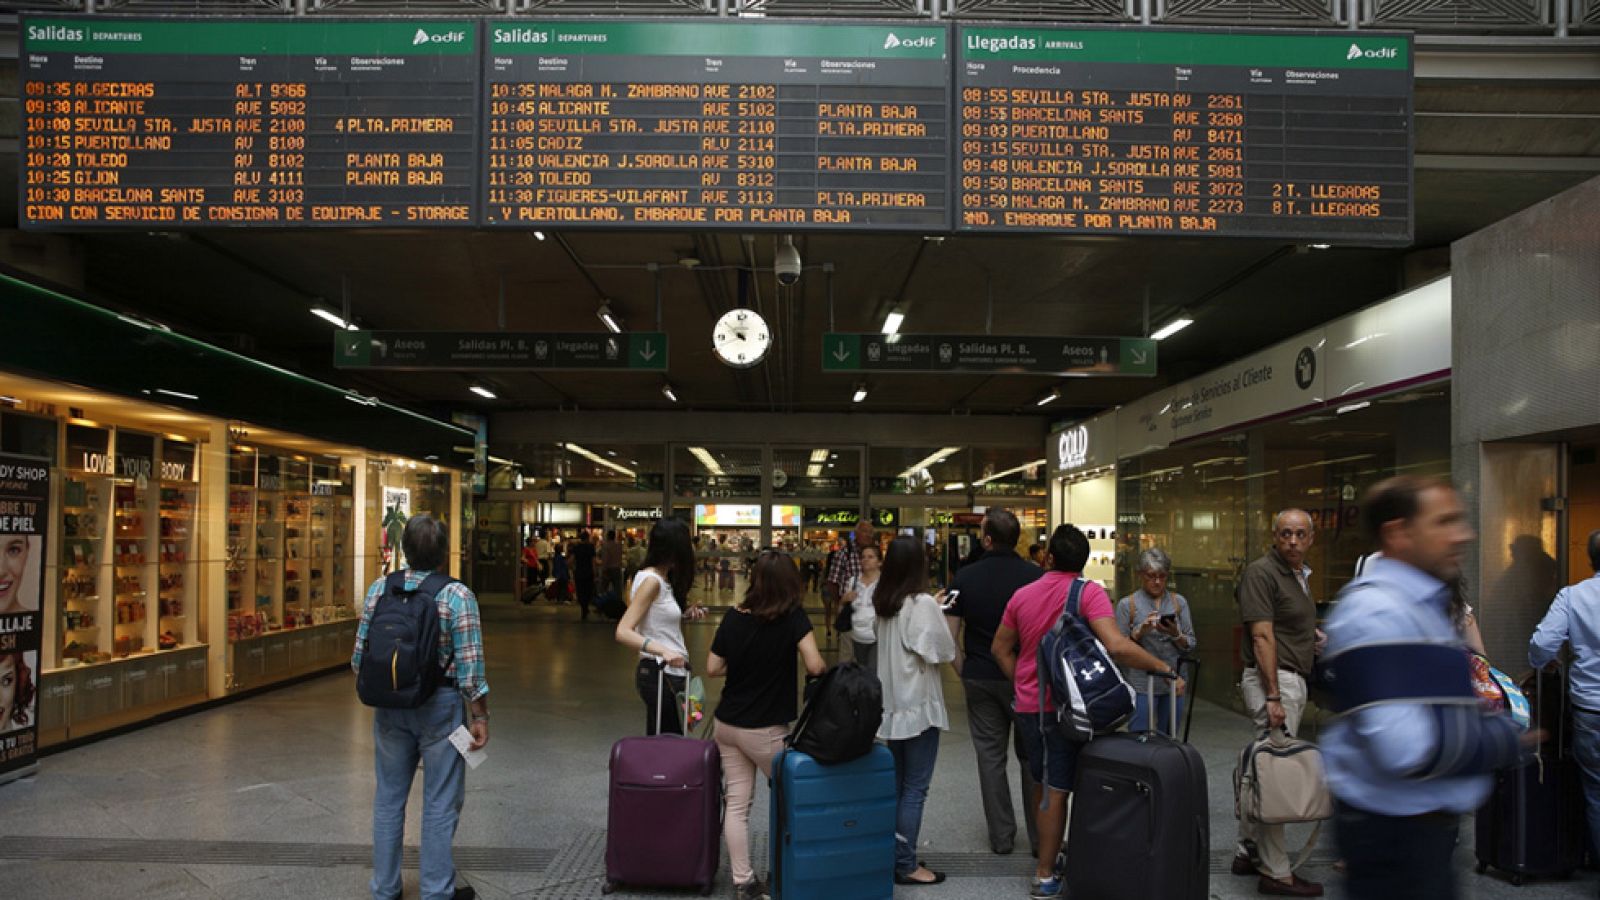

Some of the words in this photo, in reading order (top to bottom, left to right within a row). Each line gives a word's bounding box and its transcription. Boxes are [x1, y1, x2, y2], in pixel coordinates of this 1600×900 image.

[28, 26, 83, 41] Salidas
[93, 33, 142, 41] DEPARTURES
[494, 29, 547, 43] Salidas
[558, 34, 607, 42] DEPARTURES
[967, 36, 1035, 52] Llegadas
[1045, 41, 1083, 49] ARRIVALS
[1013, 65, 1060, 75] Procedencia
[1286, 71, 1338, 79] Observaciones
[74, 82, 154, 97] ALGECIRAS
[236, 84, 261, 98] ALT
[492, 84, 535, 98] 10:35
[539, 84, 593, 97] MALAGA
[628, 84, 699, 98] ZAMBRANO
[704, 85, 729, 98] AVE
[738, 85, 775, 98] 2102
[1011, 90, 1073, 104] SEVILLA
[1126, 93, 1170, 106] JUSTA
[1172, 94, 1191, 107] AV
[74, 100, 144, 114] ALICANTE
[235, 101, 261, 115] AVE
[492, 101, 534, 115] 10:45
[538, 102, 609, 115] ALICANTE
[703, 103, 730, 116] AVE
[738, 103, 775, 116] 5102
[818, 104, 873, 118] PLANTA
[880, 105, 917, 118] BAJA
[1012, 108, 1092, 123] BARCELONA
[1100, 110, 1144, 124] SANTS
[1172, 112, 1198, 125] AVE
[26, 118, 72, 132] 10:00
[74, 118, 136, 132] SEVILLA
[189, 118, 231, 132] JUSTA
[235, 119, 261, 132] AVE
[491, 119, 534, 133] 11:00
[538, 119, 600, 133] SEVILLA
[655, 119, 698, 132] JUSTA
[703, 120, 728, 133] AVE
[738, 120, 775, 134] 2110
[962, 123, 1008, 138] 09:03
[1012, 125, 1109, 140] PUERTOLLANO
[1172, 129, 1191, 141] AV
[1207, 130, 1242, 144] 8471
[26, 136, 72, 149] 10:15
[74, 136, 171, 150] PUERTOLLANO
[235, 136, 253, 149] AV
[491, 136, 535, 150] 11:05
[538, 136, 583, 150] CADIZ
[702, 138, 730, 150] ALV
[738, 138, 774, 151] 2114
[962, 141, 1008, 155] 09:15
[1011, 143, 1074, 157] SEVILLA
[1126, 146, 1170, 159] JUSTA
[1173, 146, 1199, 160] AVE
[26, 153, 71, 167] 10:20
[76, 153, 128, 168] TOLEDO
[235, 154, 252, 167] AV
[346, 153, 400, 168] PLANTA
[408, 153, 443, 168] BAJA
[491, 154, 534, 168] 11:10
[538, 154, 609, 168] VALENCIA
[618, 154, 698, 168] J.SOROLLA
[702, 156, 728, 168] AVE
[738, 156, 774, 168] 5310
[818, 157, 872, 170] PLANTA
[880, 158, 917, 171] BAJA
[963, 159, 1008, 173] 09:48
[1012, 160, 1083, 174] VALENCIA
[1091, 162, 1170, 176] J.SOROLLA
[1173, 164, 1198, 177] AVE
[26, 171, 72, 184] 10:25
[74, 171, 118, 184] GIJON
[234, 171, 261, 185] ALV
[269, 171, 303, 186] 4111
[346, 171, 400, 185] PLANTA
[408, 171, 443, 185] BAJA
[490, 172, 534, 185] 11:20
[539, 172, 592, 185] TOLEDO
[702, 173, 720, 186] AV
[737, 173, 773, 186] 8312
[26, 188, 72, 202] 10:30
[74, 188, 152, 202] BARCELONA
[160, 188, 204, 202] SANTS
[234, 189, 260, 202] AVE
[962, 176, 1008, 191] 09:50
[1012, 178, 1092, 192] BARCELONA
[1100, 179, 1144, 194] SANTS
[1173, 181, 1200, 195] AVE
[1208, 182, 1243, 196] 3072
[1311, 184, 1380, 200] LLEGADAS
[489, 189, 533, 203] 11:30
[536, 190, 688, 203] FIGUERES-VILAFANT
[702, 191, 727, 204] AVE
[738, 191, 774, 204] 3113
[70, 206, 98, 220] CON
[105, 206, 175, 220] SERVICIO
[182, 206, 200, 220] DE
[208, 206, 279, 220] CONSIGNA
[286, 206, 303, 220] DE
[312, 206, 381, 220] EQUIPAJE
[407, 206, 468, 220] STORAGE
[962, 194, 1008, 208] 09:50
[1012, 196, 1065, 209] MALAGA
[1099, 197, 1170, 211] ZAMBRANO
[1172, 198, 1200, 212] AVE
[1208, 199, 1244, 214] 2273
[1311, 202, 1380, 217] LLEGADAS
[714, 209, 743, 221] POR
[750, 209, 806, 222] PLANTA
[812, 209, 851, 222] BAJA
[1084, 214, 1112, 227] POR
[1119, 215, 1172, 228] PLANTA
[1180, 216, 1216, 230] BAJA
[394, 339, 425, 349] Aseos
[458, 339, 496, 350] Salidas
[557, 340, 599, 352] Llegadas
[959, 343, 997, 354] Salidas
[1062, 344, 1094, 356] Aseos
[1201, 381, 1231, 402] Servicios
[1241, 365, 1273, 388] Cliente
[84, 452, 113, 474] LOVE
[122, 457, 151, 478] YOUR
[161, 461, 185, 480] BODY
[13, 517, 35, 531] PIEL
